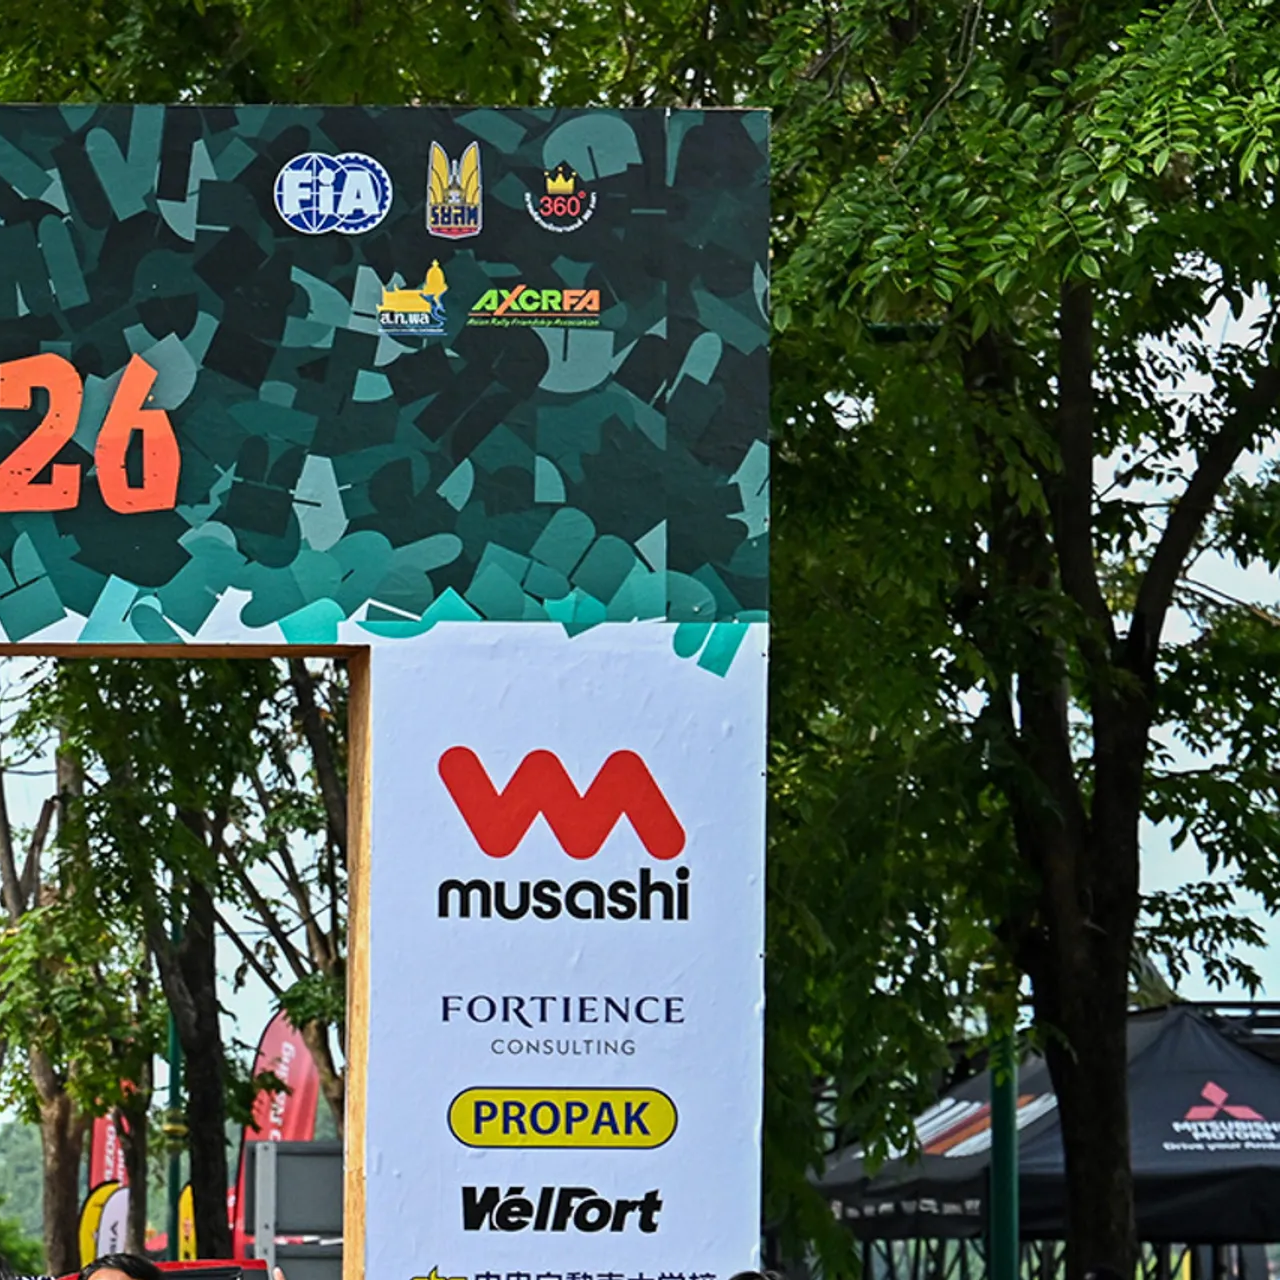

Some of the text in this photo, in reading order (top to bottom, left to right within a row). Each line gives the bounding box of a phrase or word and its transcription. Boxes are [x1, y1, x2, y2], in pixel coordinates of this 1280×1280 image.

[472, 285, 600, 314] AXCRFA
[438, 867, 689, 921] musashi
[441, 996, 685, 1028] FORTIENCE
[491, 1039, 636, 1055] CONSULTING
[473, 1101, 651, 1135] PROPAK
[1173, 1121, 1280, 1132] MITSUBISH
